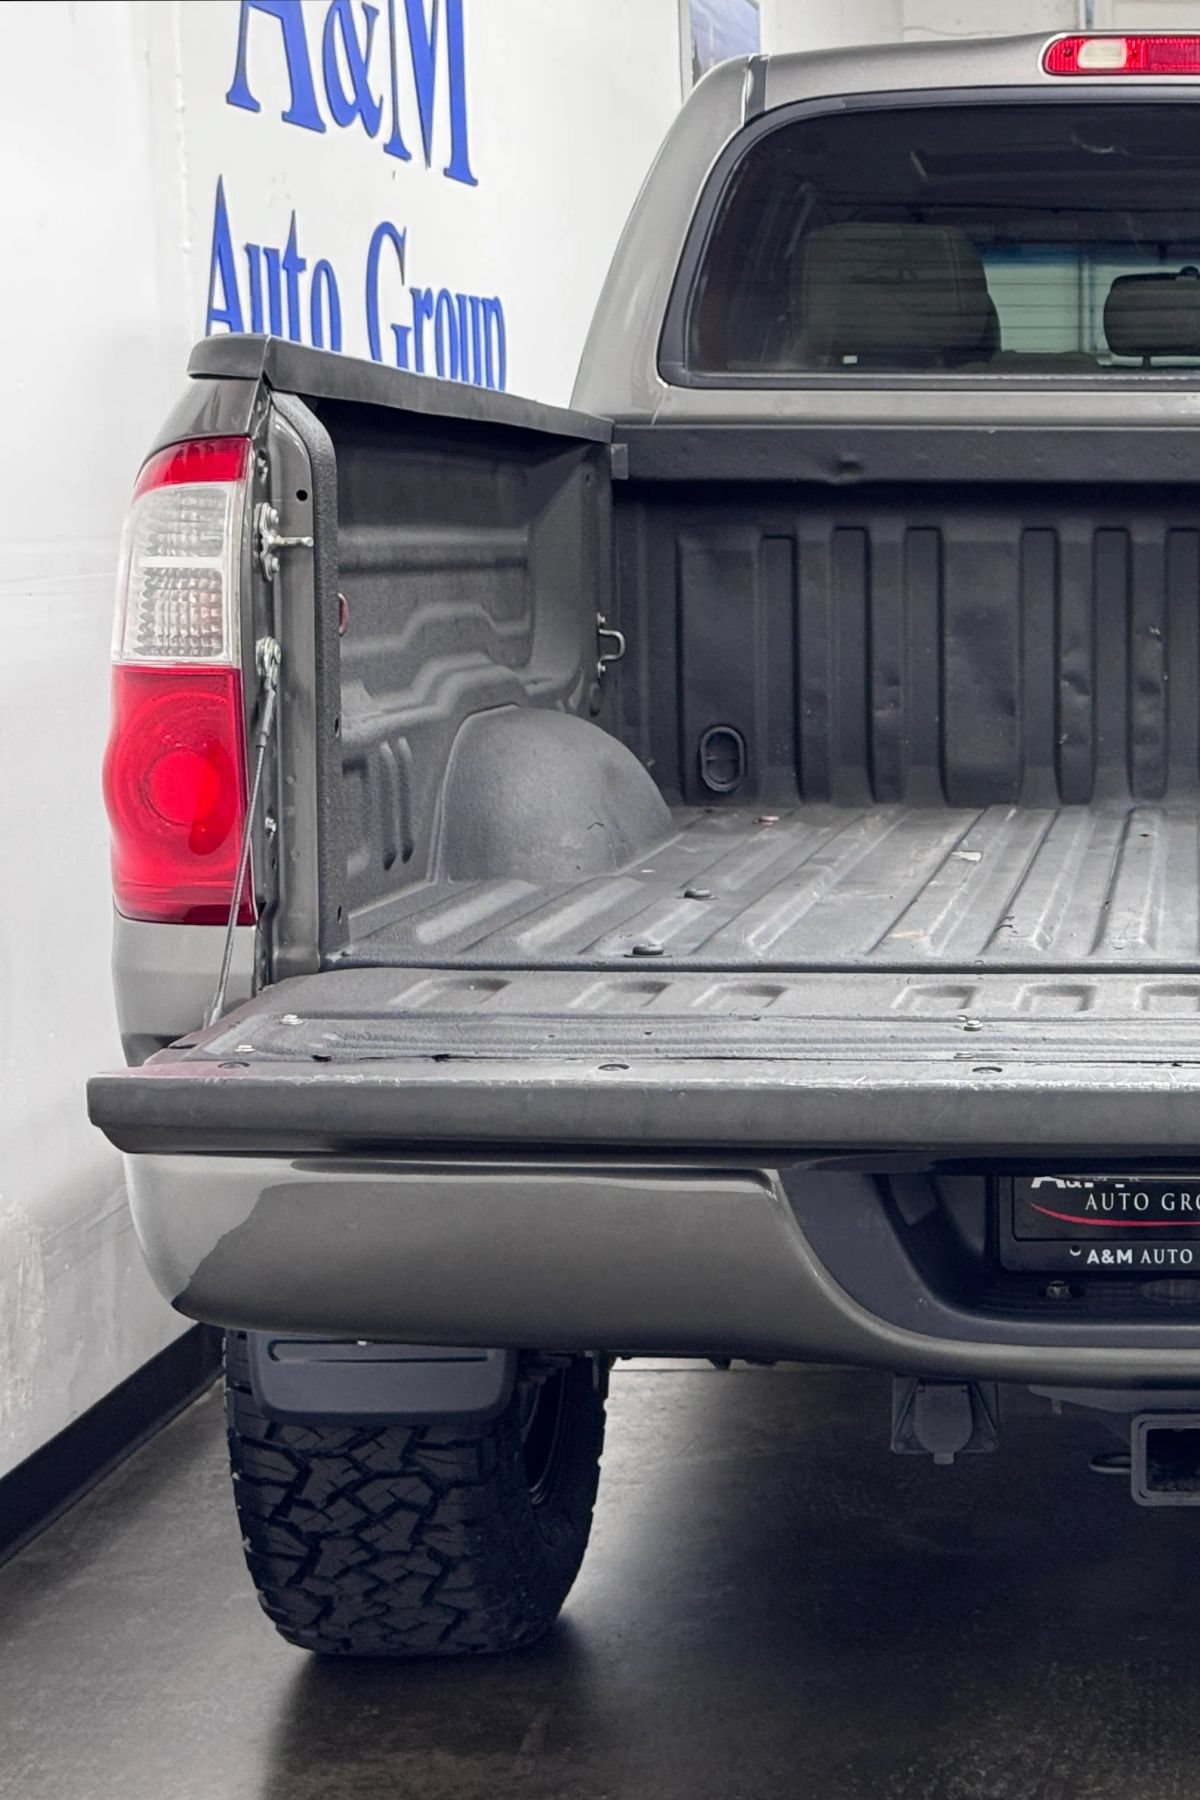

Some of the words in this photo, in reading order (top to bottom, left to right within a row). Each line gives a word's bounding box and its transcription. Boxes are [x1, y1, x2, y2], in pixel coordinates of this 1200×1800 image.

[205, 173, 342, 353] Auto
[1084, 1192, 1149, 1211] AUTO
[1086, 1248, 1133, 1265] A&M
[1140, 1248, 1193, 1265] AUTO
